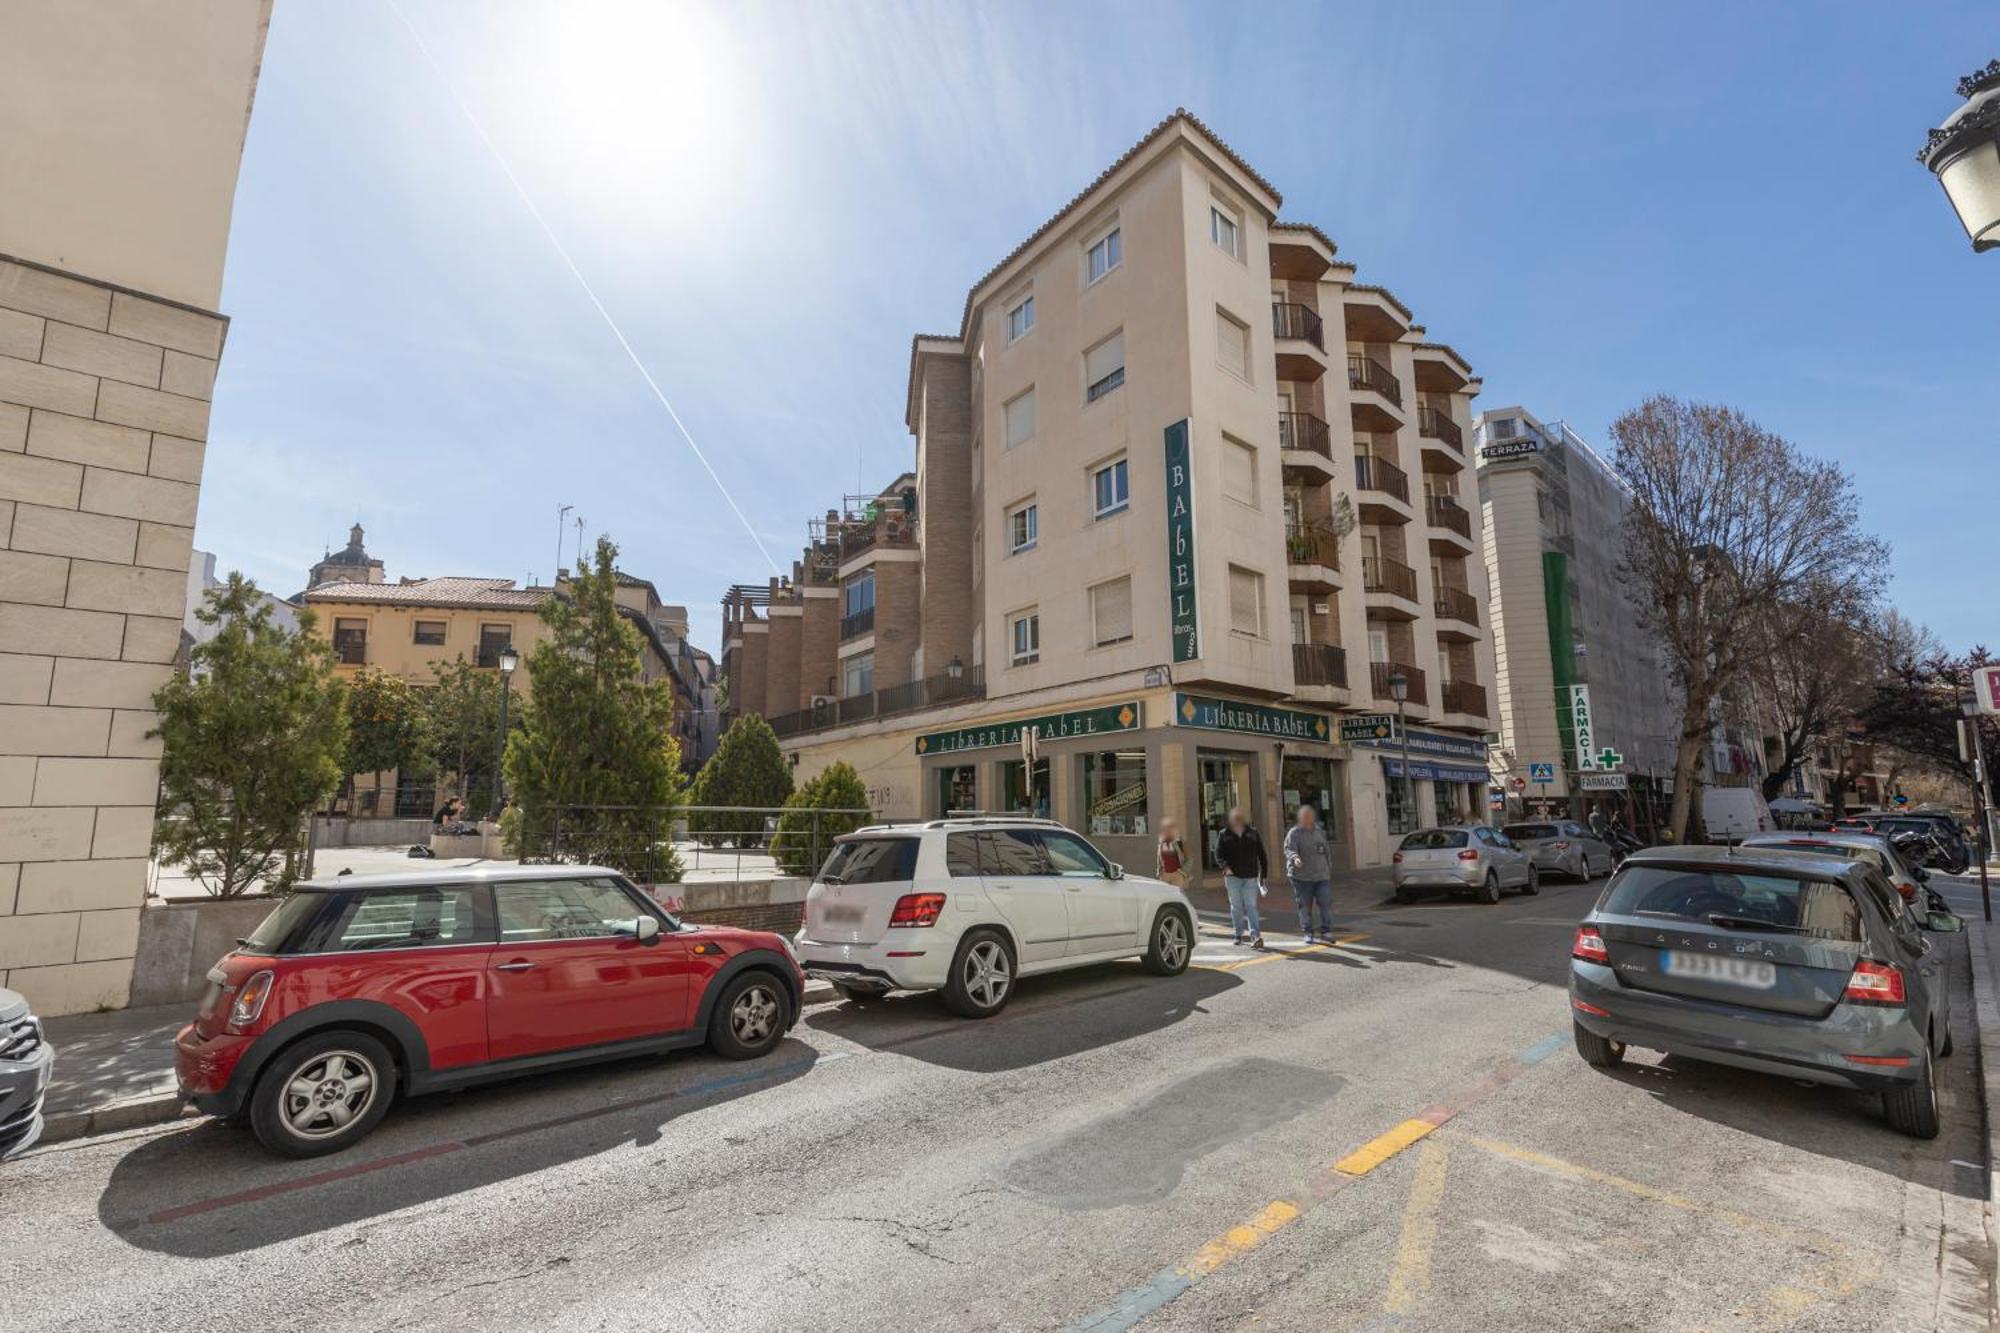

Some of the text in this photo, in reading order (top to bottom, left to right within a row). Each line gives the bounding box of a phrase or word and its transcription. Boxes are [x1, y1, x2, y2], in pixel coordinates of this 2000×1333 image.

[1483, 443, 1536, 457] TERRAZA
[1575, 687, 1592, 769] FARMACIA
[1582, 776, 1625, 788] FARMACIA
[1095, 786, 1143, 817] OPOSICIONES
